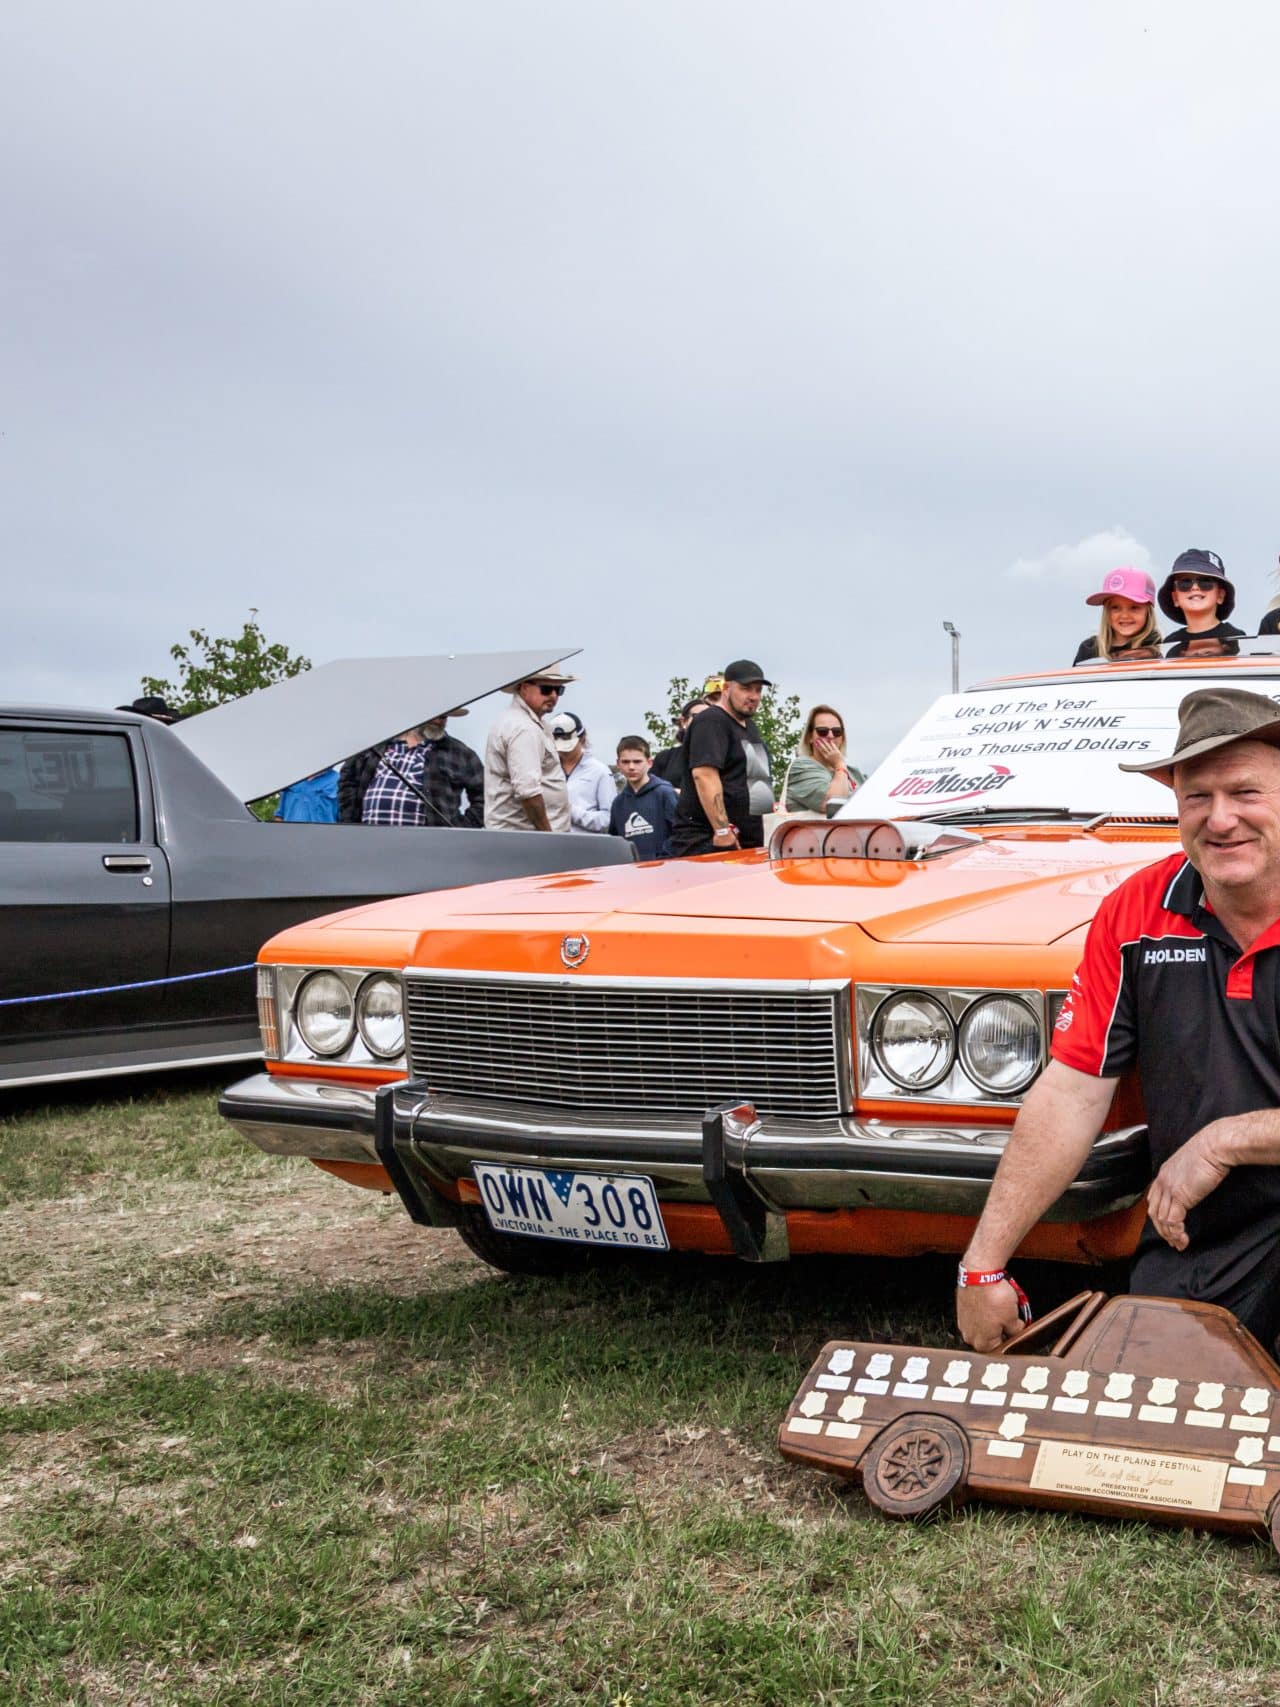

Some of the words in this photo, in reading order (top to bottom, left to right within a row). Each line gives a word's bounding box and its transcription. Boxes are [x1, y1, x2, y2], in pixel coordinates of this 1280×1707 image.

[955, 706, 986, 719] Ute
[989, 703, 1013, 716] Of
[1015, 700, 1048, 714] The
[1054, 698, 1098, 711] Year
[967, 720, 1030, 736] SHOW
[1033, 717, 1058, 730] 'N'
[1058, 715, 1126, 729] SHINE
[938, 746, 973, 759] Two
[977, 738, 1070, 757] Thousand
[1073, 737, 1152, 752] Dollars
[888, 773, 1017, 797] UteMuster
[1143, 947, 1207, 965] HOLDEN
[482, 1172, 554, 1223] OWN
[575, 1182, 653, 1231] 308
[497, 1217, 545, 1234] VICTORIA
[558, 1226, 580, 1239] THE
[584, 1228, 619, 1242] PLACE
[622, 1232, 639, 1244] TO
[644, 1234, 659, 1246] BE
[1062, 1448, 1083, 1459] PLAY
[1085, 1451, 1099, 1461] ON
[1103, 1453, 1121, 1463] THE
[1123, 1455, 1157, 1468] PLAINS
[1159, 1459, 1203, 1473] FESTIVAL
[1092, 1487, 1150, 1501] ACCOMMODATION
[1149, 1495, 1193, 1507] ASSOCIATION
[1100, 1482, 1139, 1493] PRESENTED
